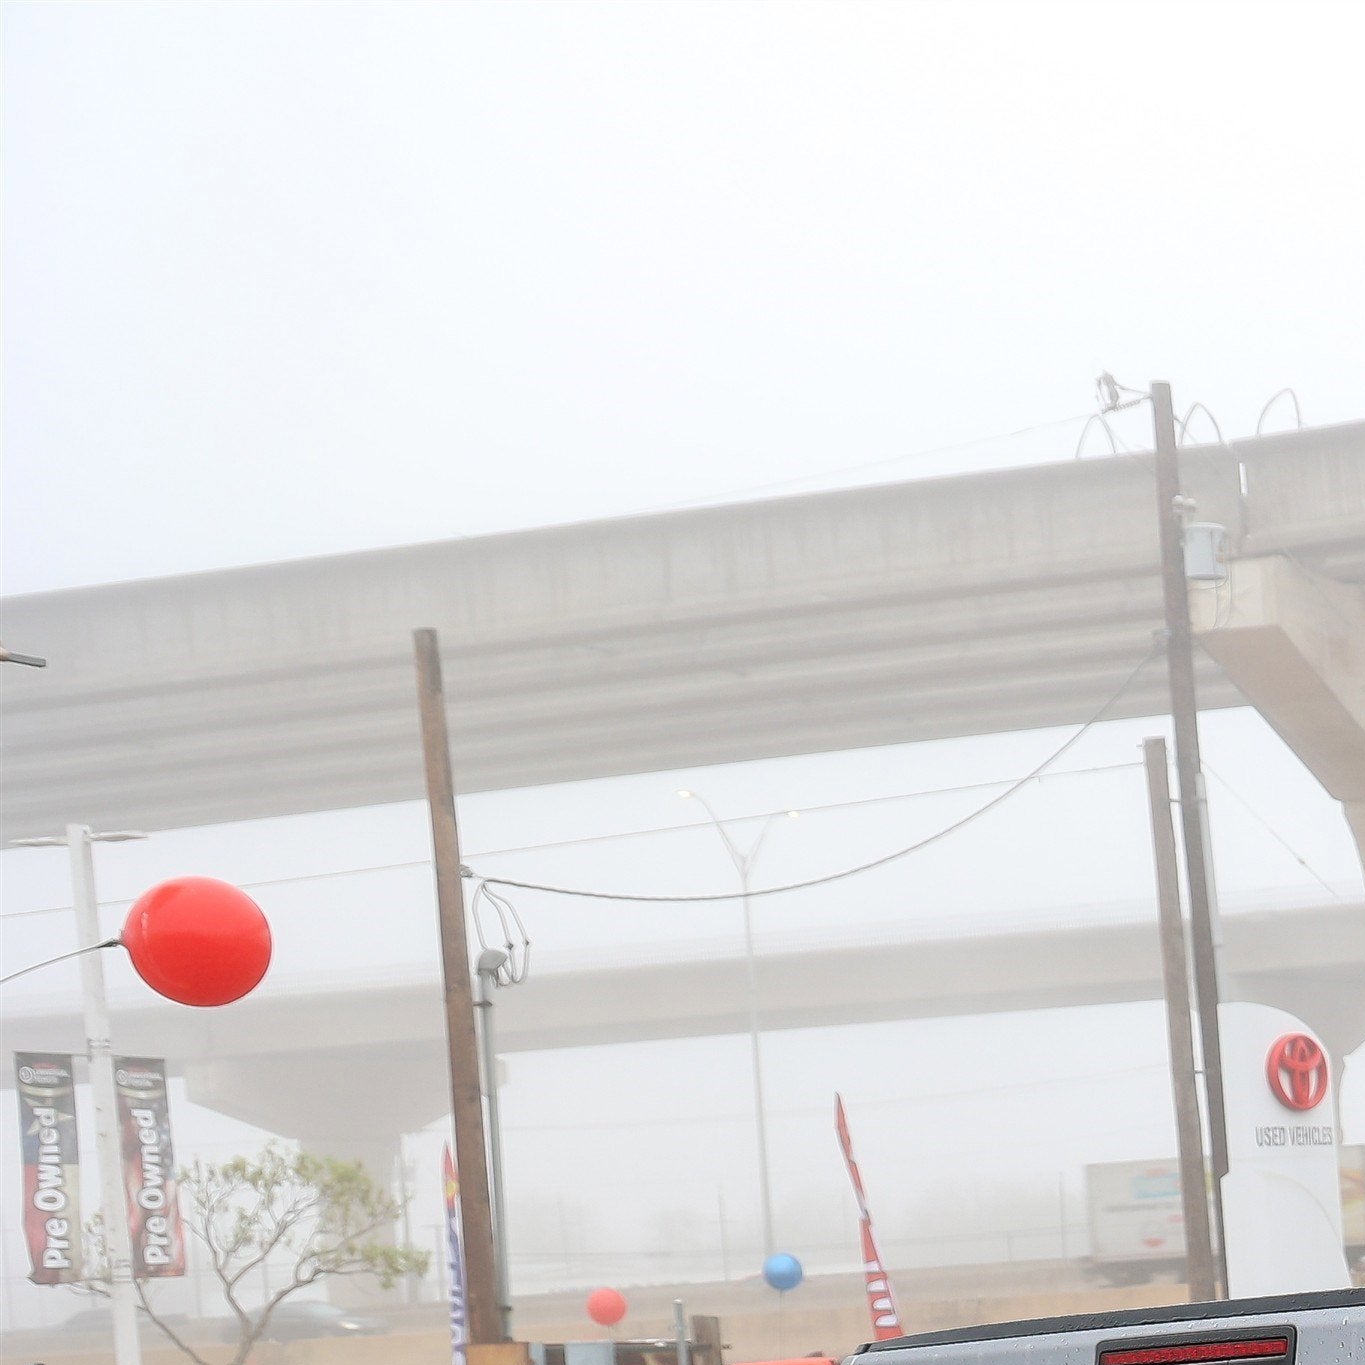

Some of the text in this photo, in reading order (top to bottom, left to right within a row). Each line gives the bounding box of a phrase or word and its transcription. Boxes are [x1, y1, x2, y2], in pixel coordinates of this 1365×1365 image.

[33, 1106, 66, 1212] Owned
[130, 1109, 165, 1210] Owned
[1255, 1126, 1333, 1146] USED VEHICLES
[43, 1218, 70, 1268] Pre
[143, 1216, 170, 1265] Pre
